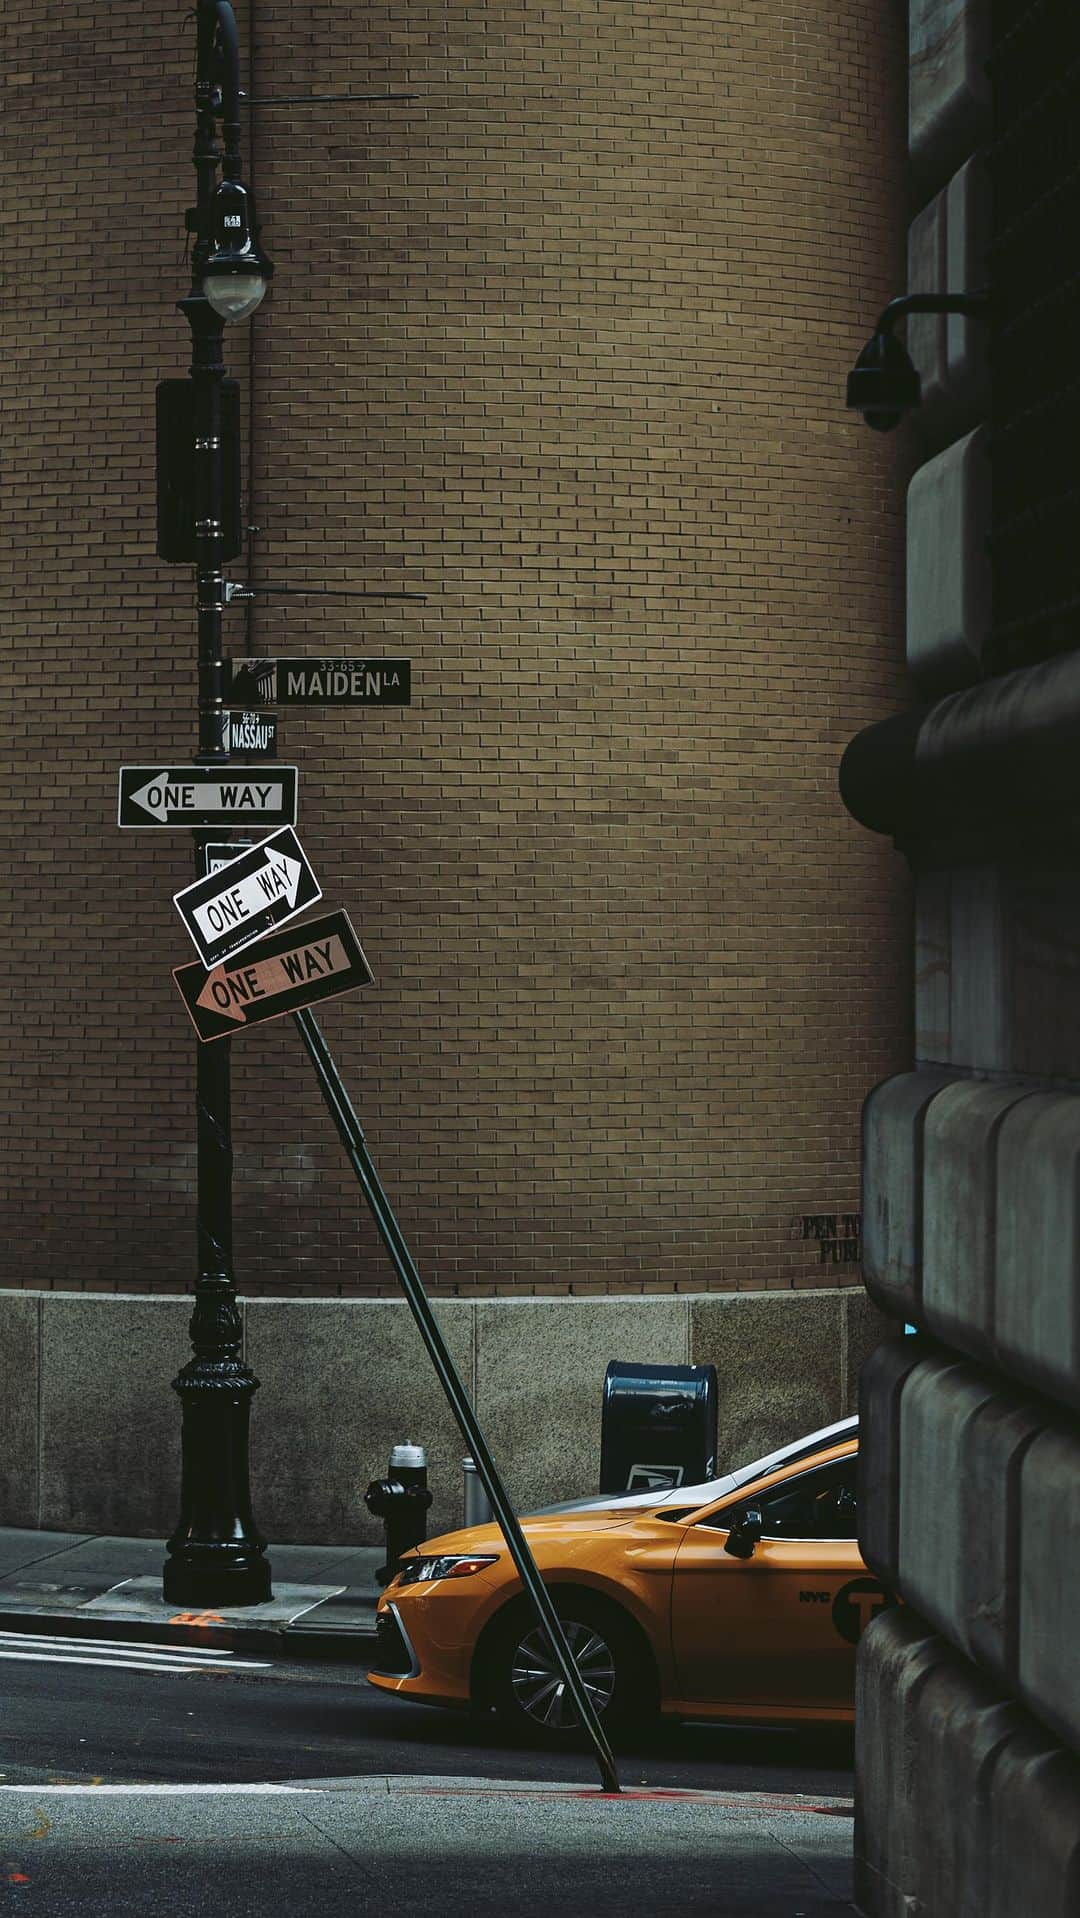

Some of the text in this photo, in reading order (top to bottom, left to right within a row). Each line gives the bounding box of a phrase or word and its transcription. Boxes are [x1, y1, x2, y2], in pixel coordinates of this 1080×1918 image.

[320, 660, 355, 671] 33-65
[287, 672, 400, 696] MAIDEN LA
[232, 723, 275, 749] NASSAU ST
[147, 786, 273, 808] ONE WAY
[206, 858, 293, 932] ONE WAY
[211, 941, 336, 1009] ONE WAY
[799, 1591, 831, 1602] NYC
